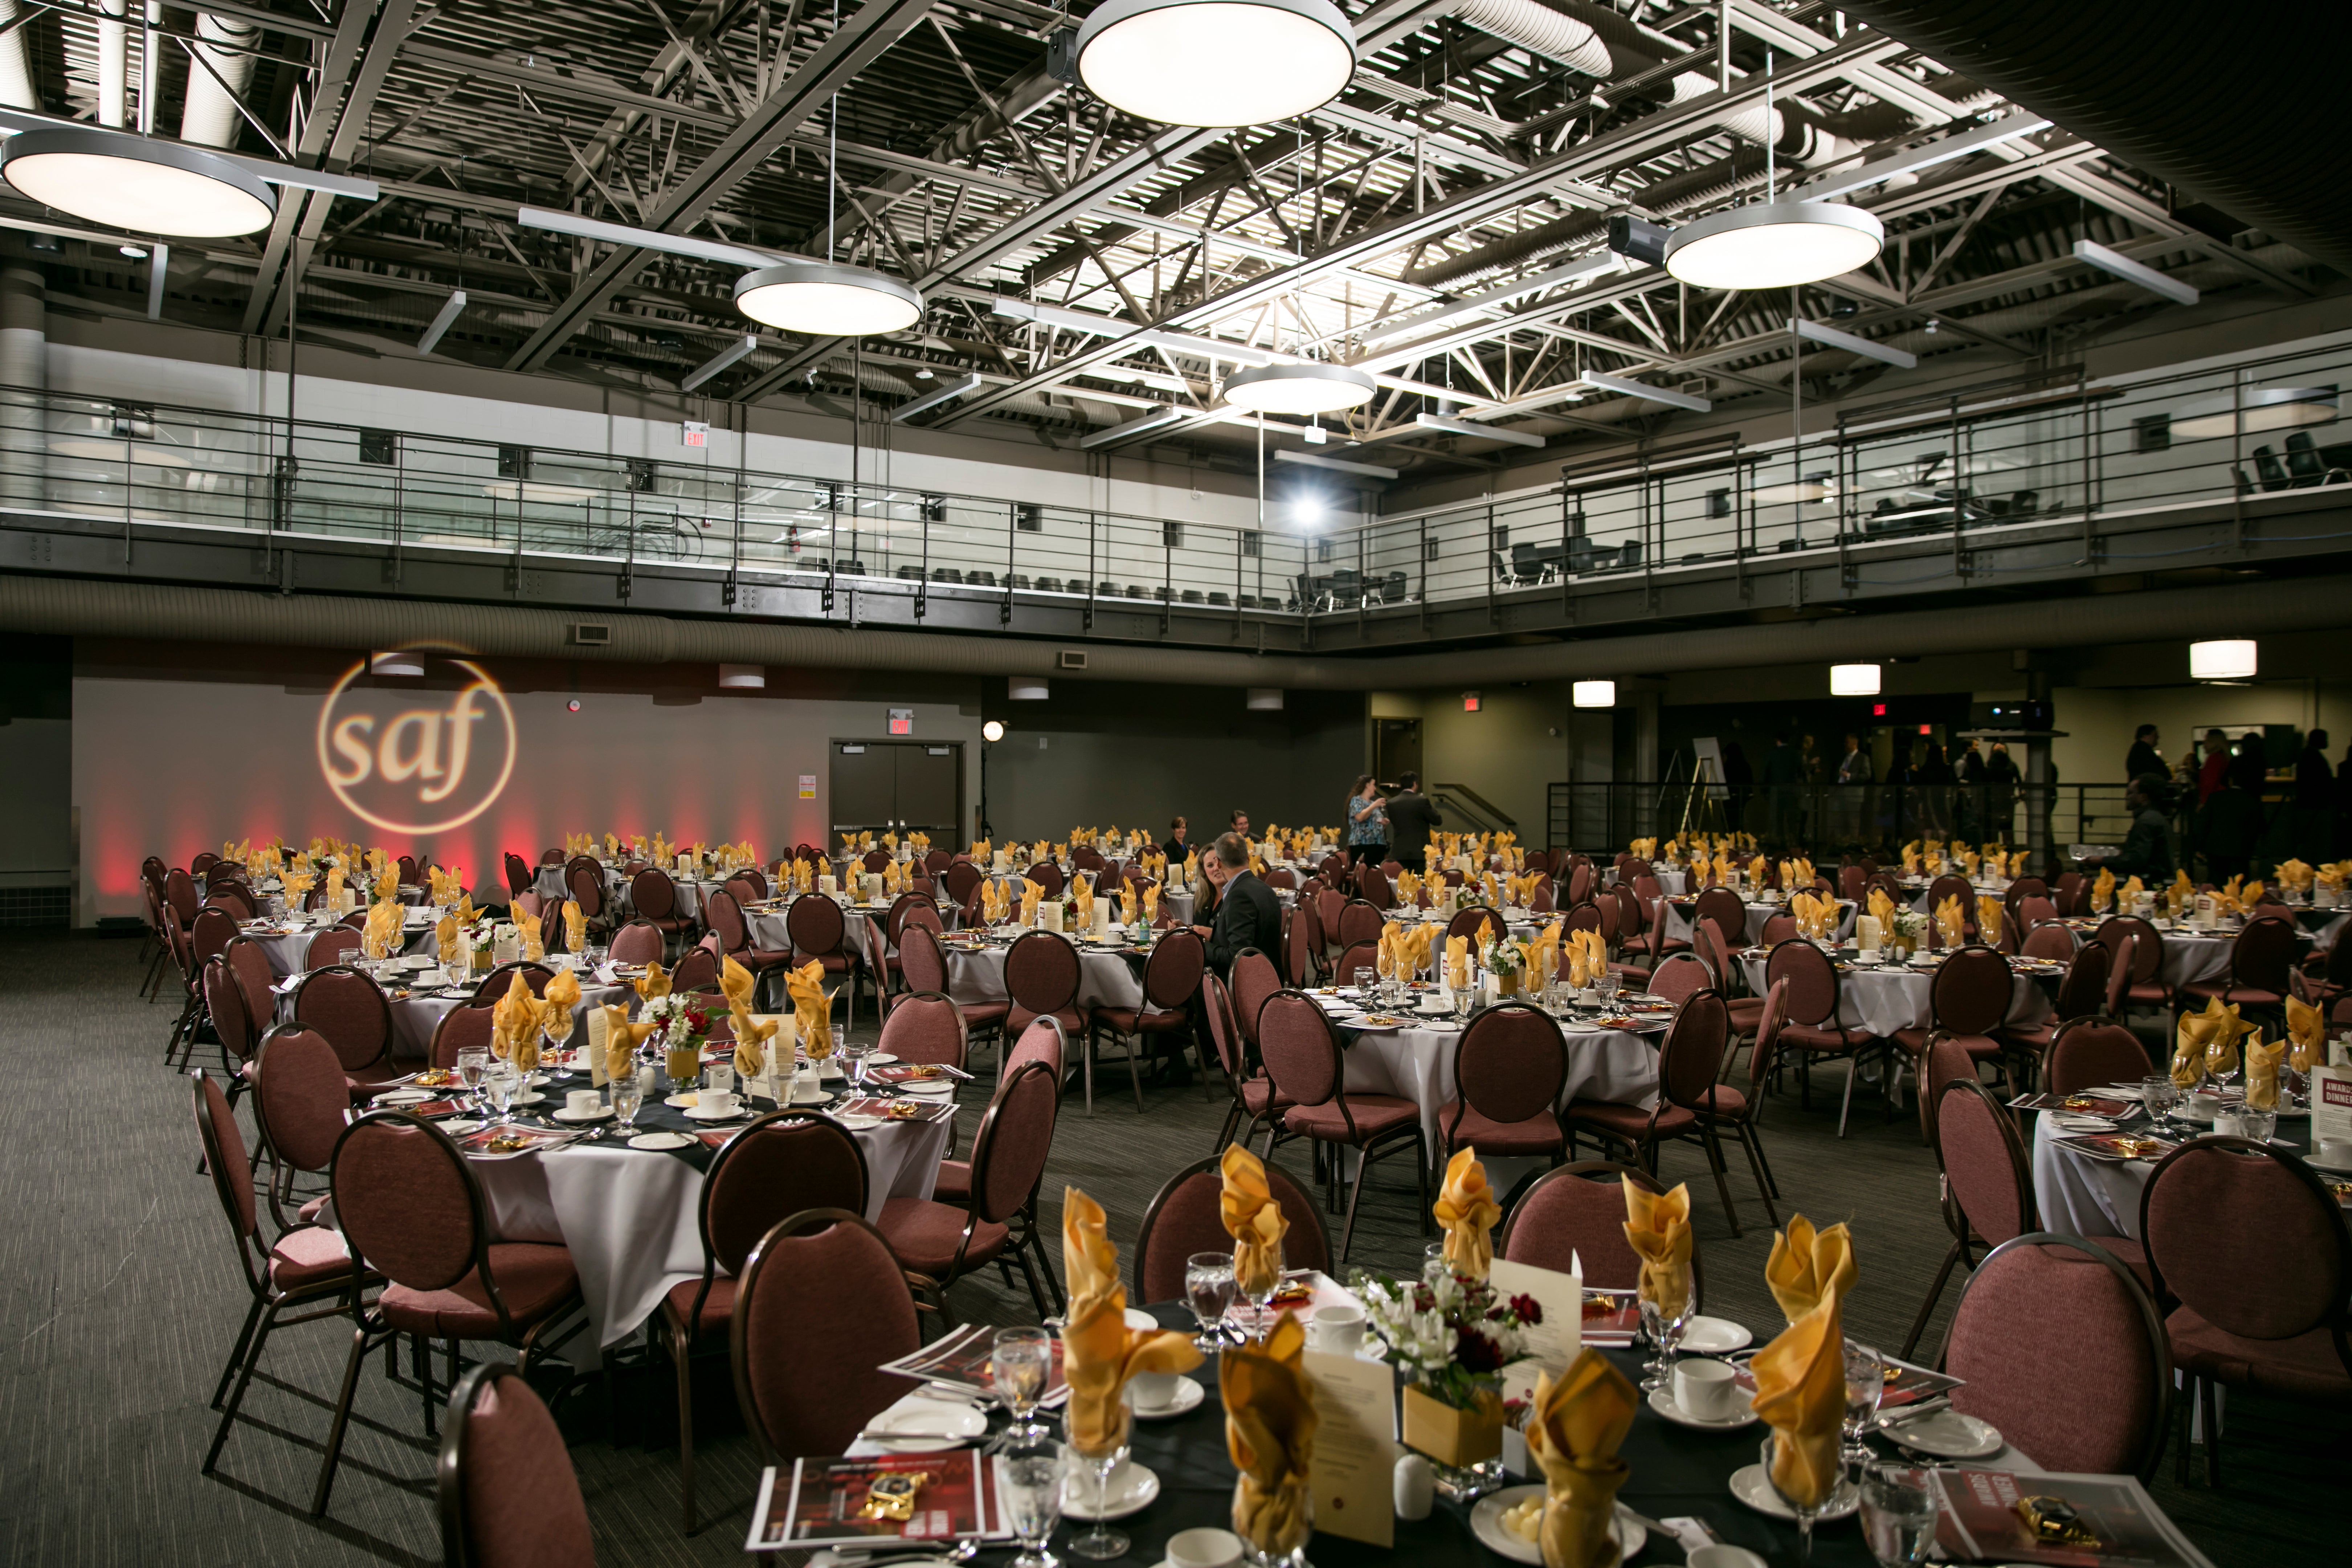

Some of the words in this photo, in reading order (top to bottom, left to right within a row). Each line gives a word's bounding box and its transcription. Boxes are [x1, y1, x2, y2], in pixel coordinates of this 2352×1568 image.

[688, 432, 704, 446] EXIT
[893, 719, 908, 734] EXIT
[332, 681, 496, 803] saf
[1481, 974, 1485, 989] 1
